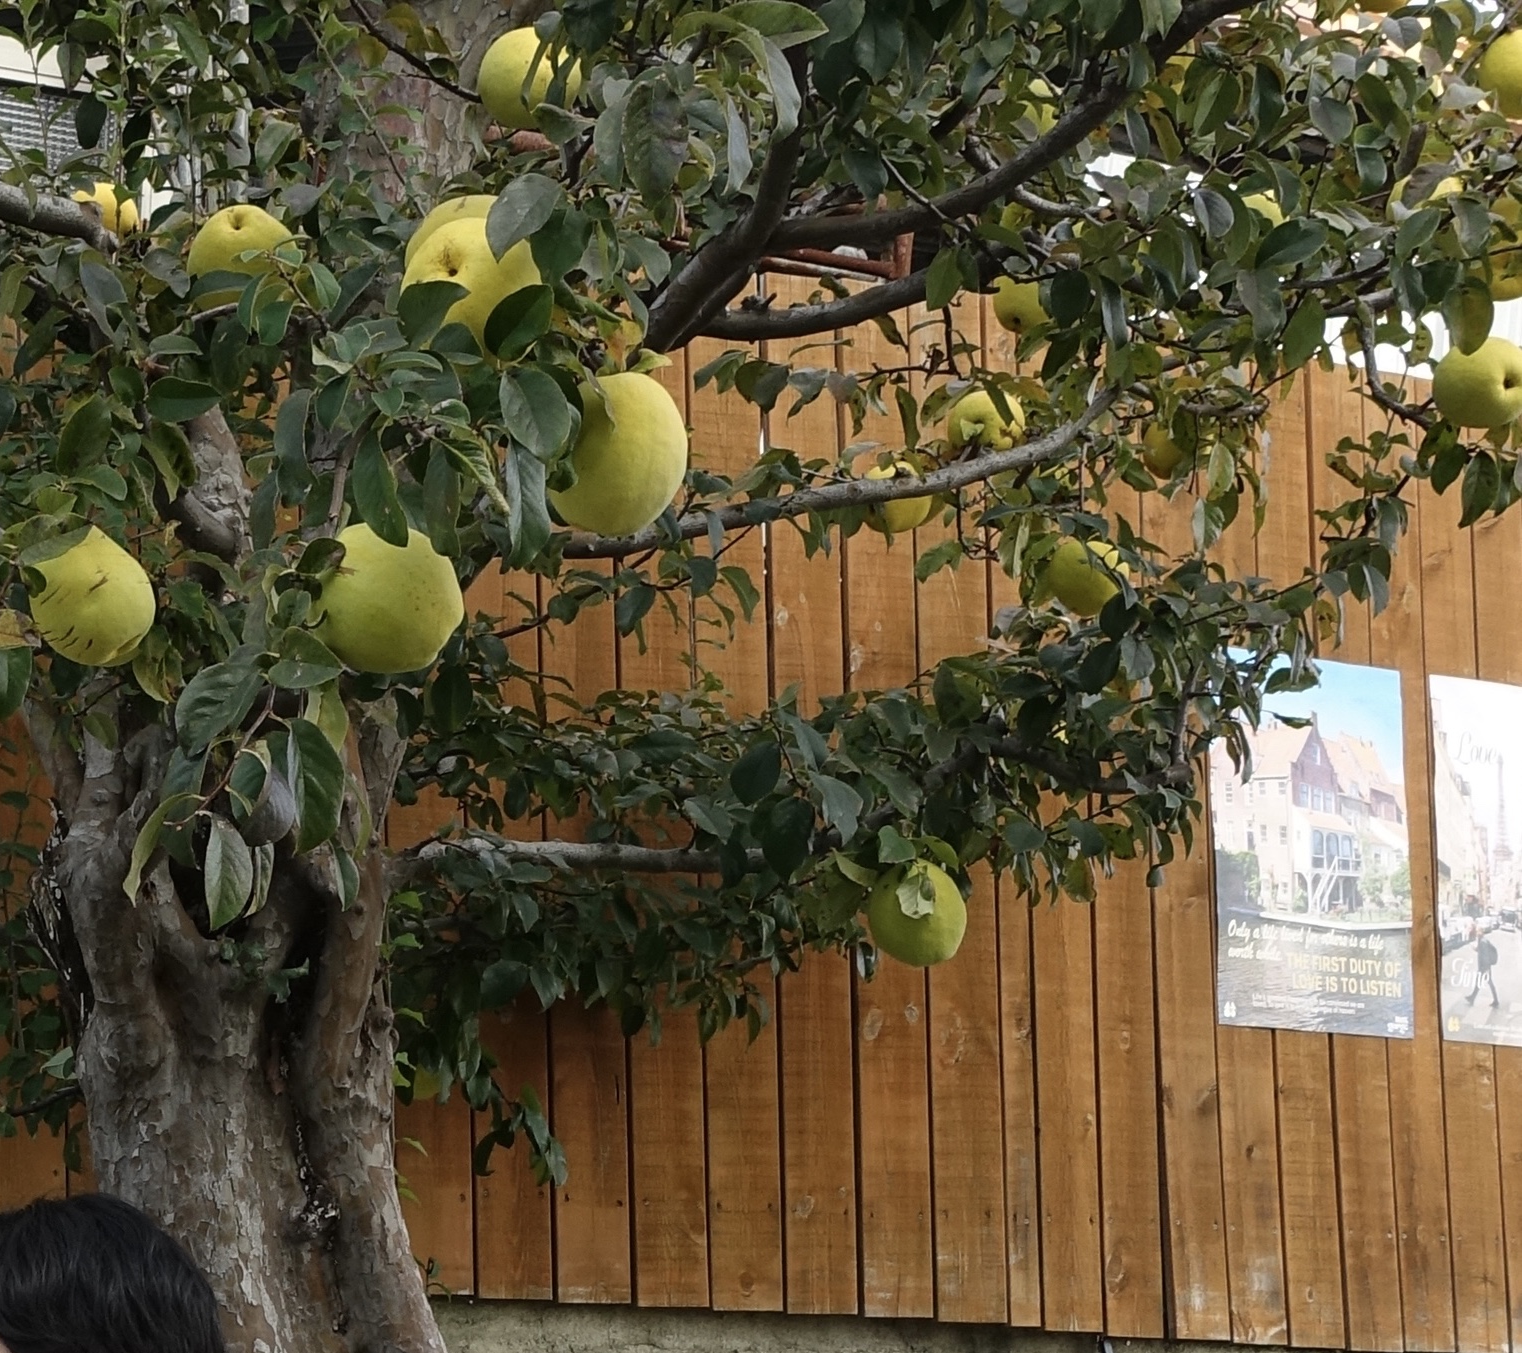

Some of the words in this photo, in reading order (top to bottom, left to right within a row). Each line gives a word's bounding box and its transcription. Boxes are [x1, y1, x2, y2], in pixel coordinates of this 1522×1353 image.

[1454, 731, 1497, 766] Love
[1228, 919, 1251, 943] Only
[1252, 929, 1261, 939] a
[1349, 934, 1358, 948] is
[1359, 939, 1367, 949] a
[1368, 934, 1384, 956] life
[1287, 952, 1310, 969] THE
[1312, 954, 1348, 973] FIRST
[1350, 957, 1382, 976] DUTY
[1384, 961, 1402, 979] OF
[1451, 957, 1490, 989] Time
[1292, 973, 1323, 991] LOVE
[1326, 976, 1338, 993] IS
[1341, 978, 1358, 994] TO
[1360, 979, 1402, 998] LISTEN
